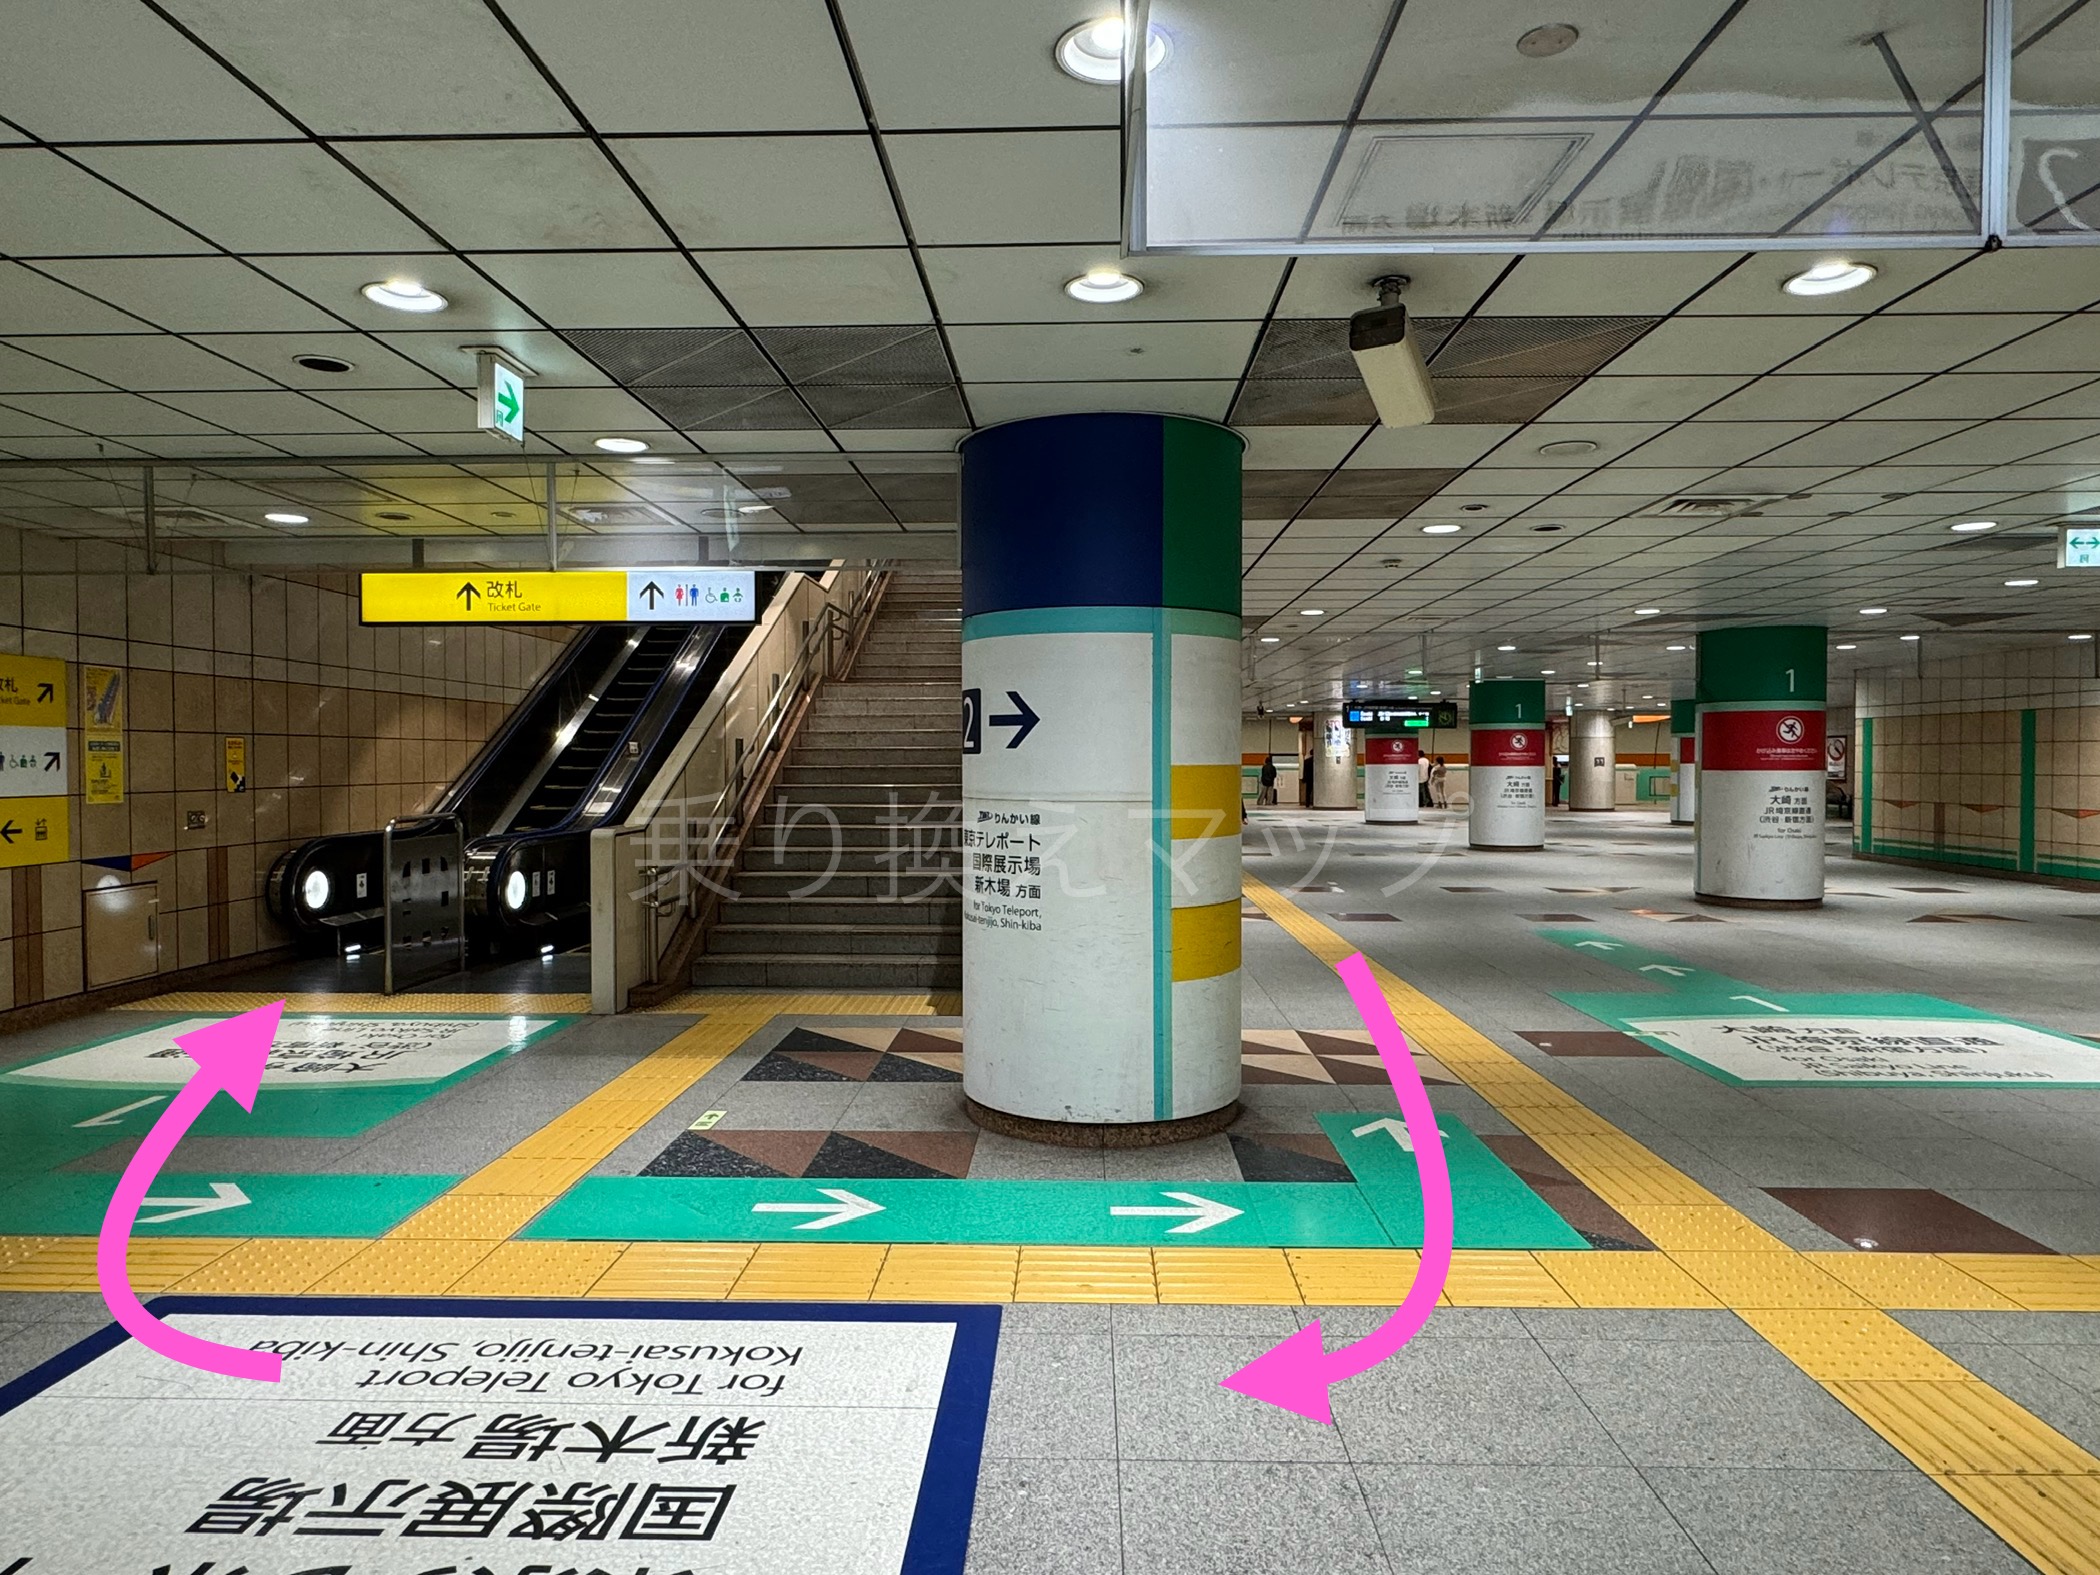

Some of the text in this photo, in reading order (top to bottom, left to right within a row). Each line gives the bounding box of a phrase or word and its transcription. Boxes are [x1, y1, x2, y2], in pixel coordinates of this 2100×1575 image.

[486, 580, 522, 599] 改札
[487, 602, 541, 613] Ticket Gate
[0, 676, 18, 693] 札
[1785, 668, 1795, 693] 1
[1515, 703, 1522, 719] 1
[962, 696, 975, 749] 2
[1770, 794, 1791, 805] 大崎
[994, 813, 1041, 825] りんかい線
[963, 829, 1041, 852] 東京テレポート
[972, 853, 1041, 876] 国際展示場
[975, 875, 1041, 899] 新木場 方面
[981, 900, 1001, 915] Tokyo
[1002, 904, 1042, 919] Teleport,
[1000, 917, 1042, 931] Shin-kiba
[249, 1337, 803, 1366] Kokusai-tenjijo, Shin-kiba
[356, 1366, 786, 1397] for Tokyo Teleport
[184, 1476, 739, 1542] 国際展示場
